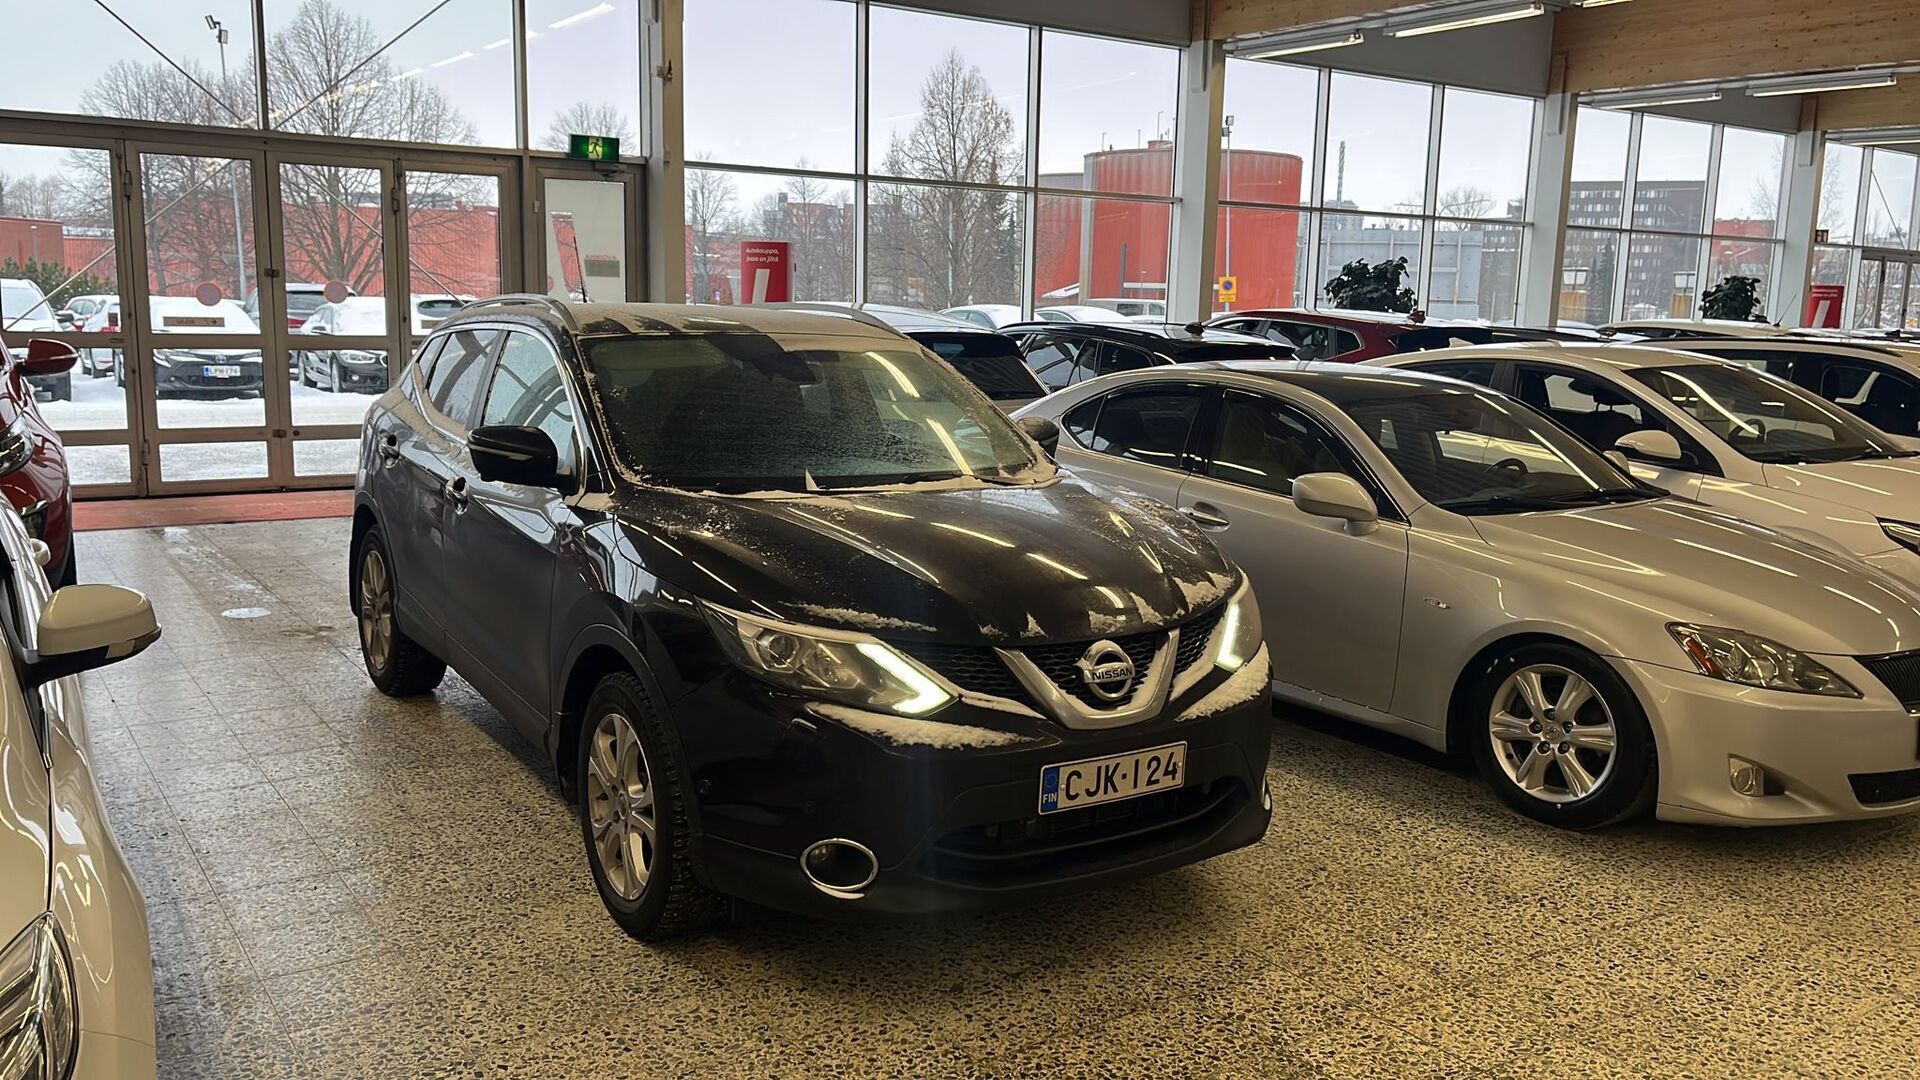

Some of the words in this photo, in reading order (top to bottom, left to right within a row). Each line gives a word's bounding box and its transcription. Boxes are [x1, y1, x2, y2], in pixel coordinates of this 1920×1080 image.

[1092, 666, 1132, 681] NISSAN
[1042, 792, 1058, 804] FIN
[1065, 752, 1178, 800] CJK-124
